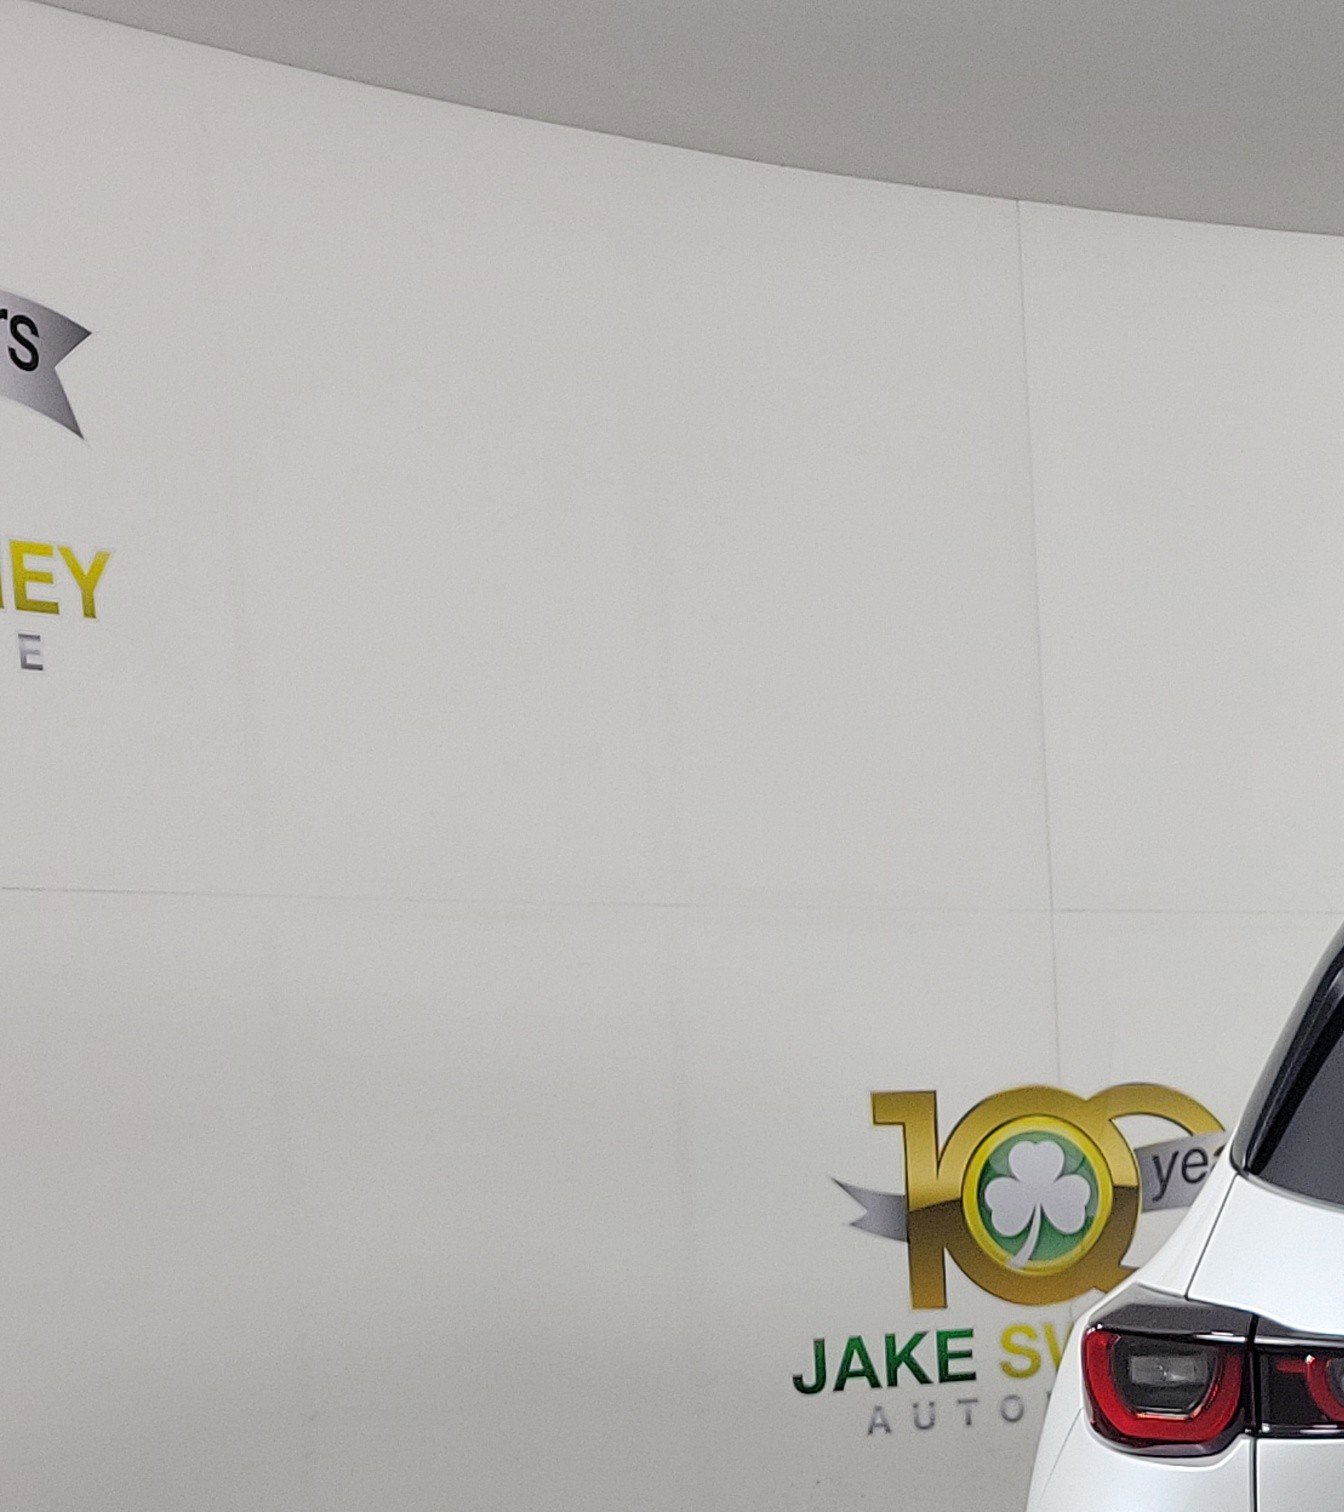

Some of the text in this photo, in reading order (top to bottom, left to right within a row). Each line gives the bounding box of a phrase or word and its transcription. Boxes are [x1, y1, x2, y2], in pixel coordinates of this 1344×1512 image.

[1152, 1144, 1226, 1202] ye
[792, 1328, 977, 1395] JAKE
[868, 1391, 1052, 1436] AUTO
